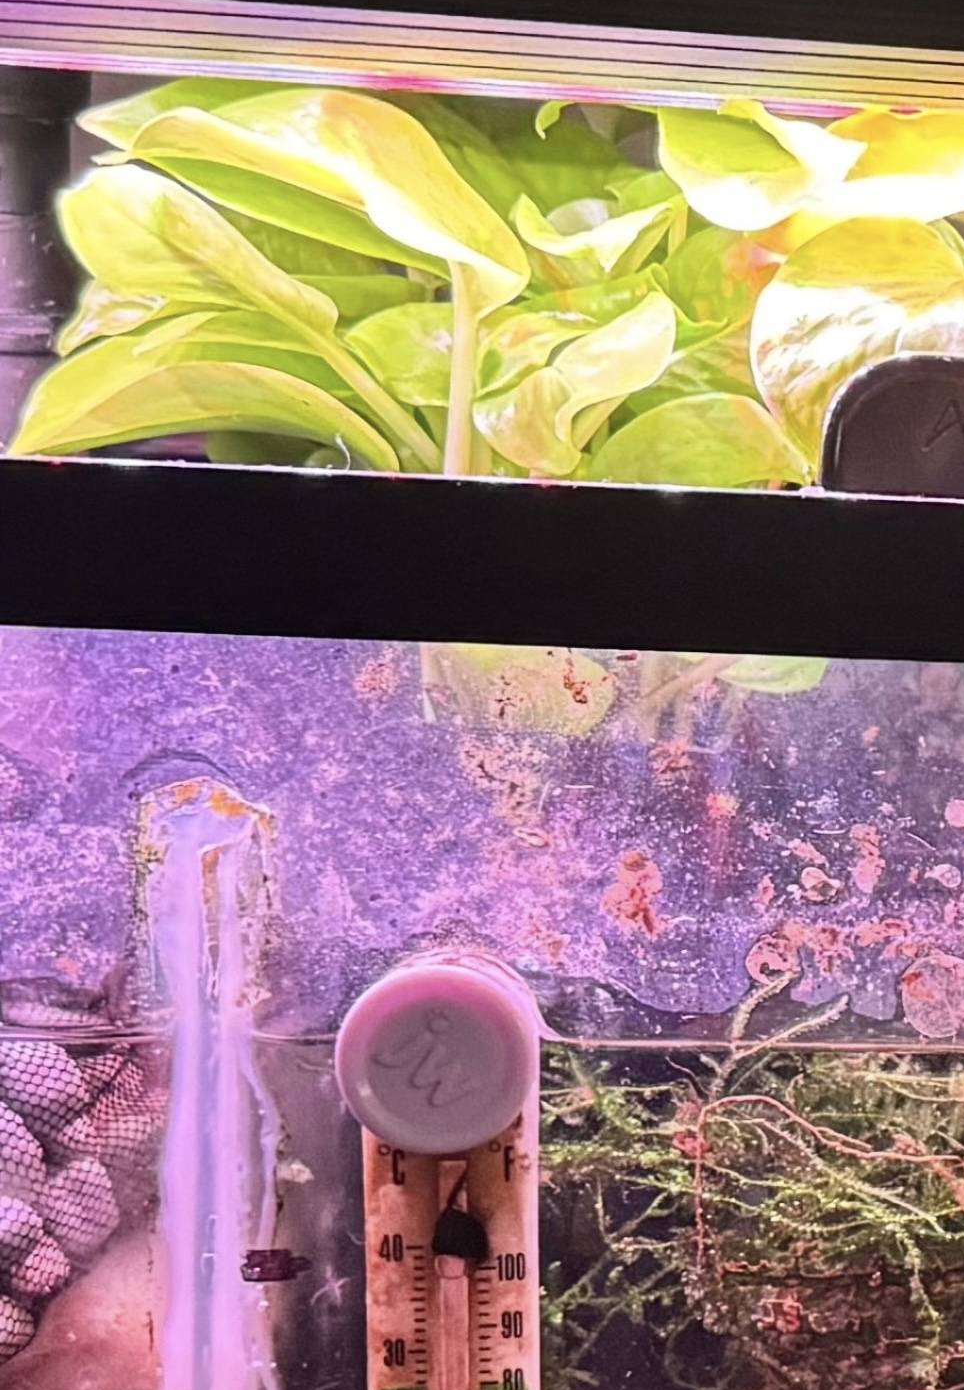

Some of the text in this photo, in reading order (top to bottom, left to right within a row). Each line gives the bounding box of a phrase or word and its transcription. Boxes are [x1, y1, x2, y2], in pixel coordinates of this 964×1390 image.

[379, 1234, 403, 1261] 40
[497, 1252, 526, 1281] 100
[501, 1311, 523, 1338] 90
[383, 1338, 405, 1366] 30
